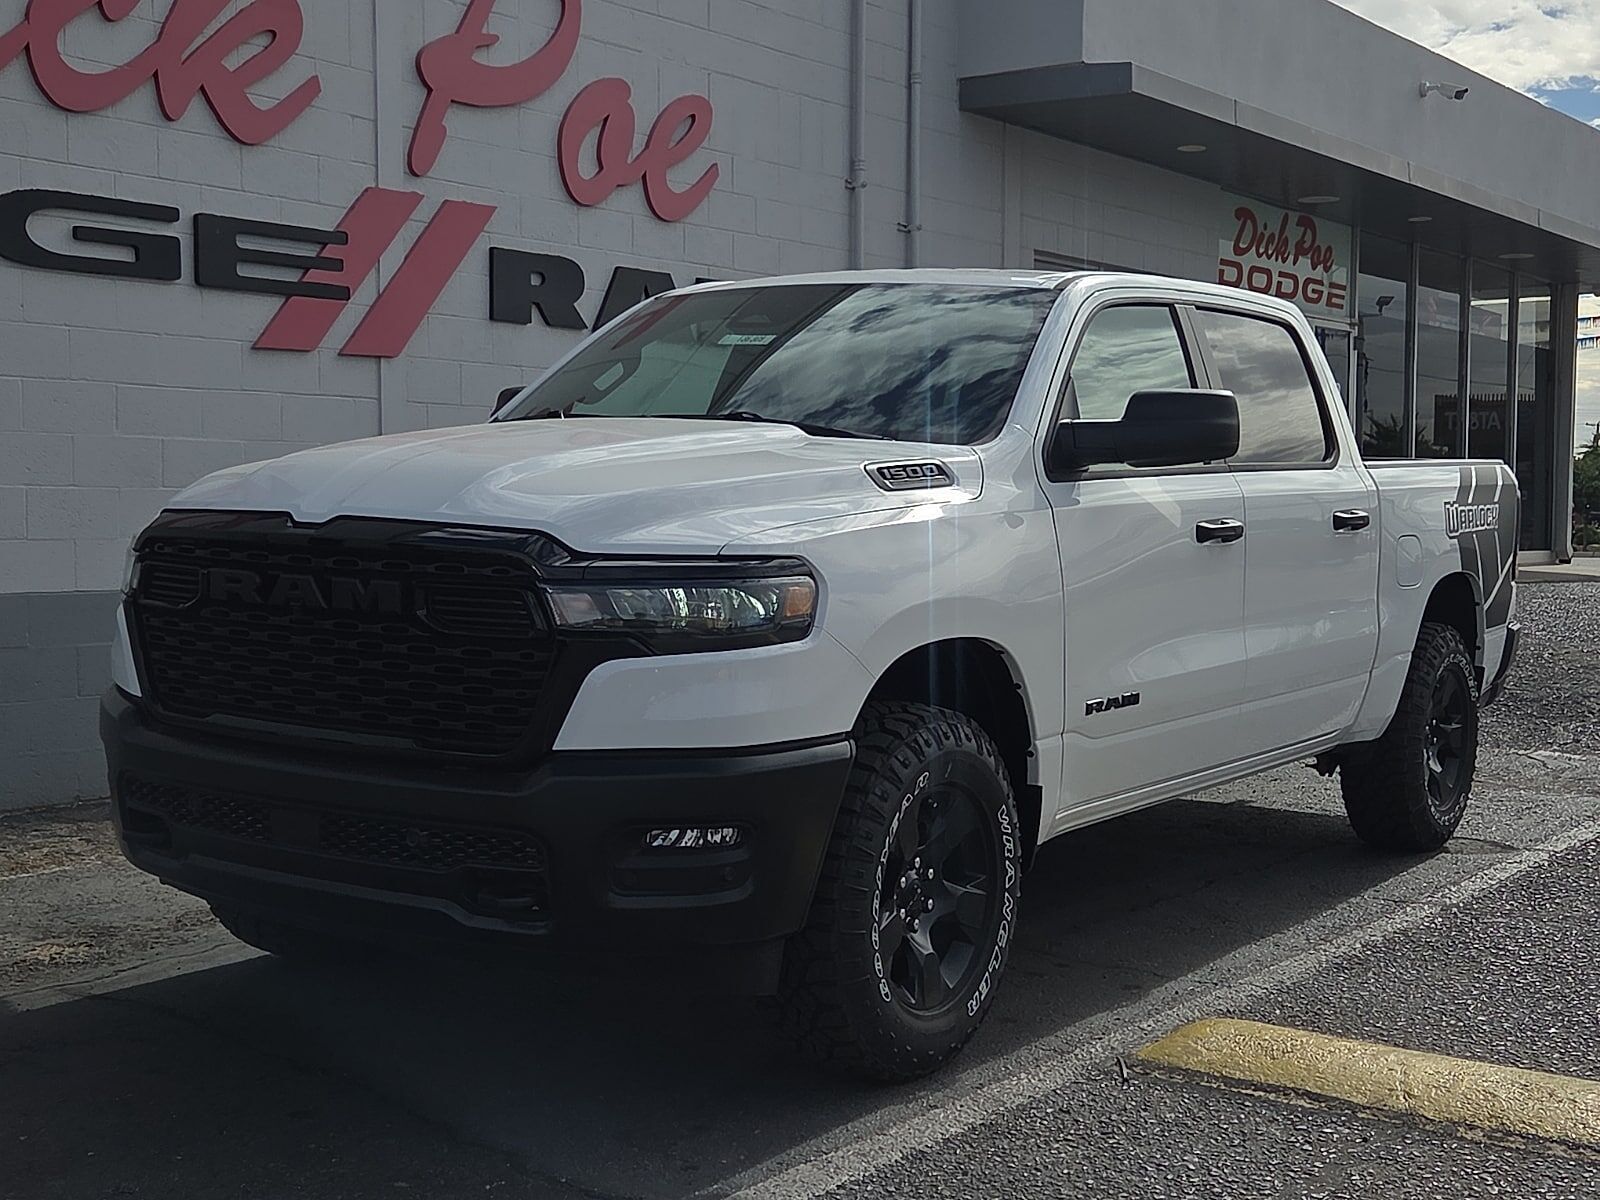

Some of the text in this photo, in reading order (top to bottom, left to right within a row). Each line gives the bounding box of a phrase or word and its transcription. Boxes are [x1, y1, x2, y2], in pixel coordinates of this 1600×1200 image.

[406, 0, 719, 223] Poe
[1232, 206, 1335, 273] Dick Poe
[489, 246, 735, 333] RA
[1218, 258, 1347, 310] DODGE
[880, 464, 939, 479] 1500
[208, 568, 402, 612] RAM
[1084, 692, 1140, 716] RAM
[967, 804, 1017, 1017] WRANGLER
